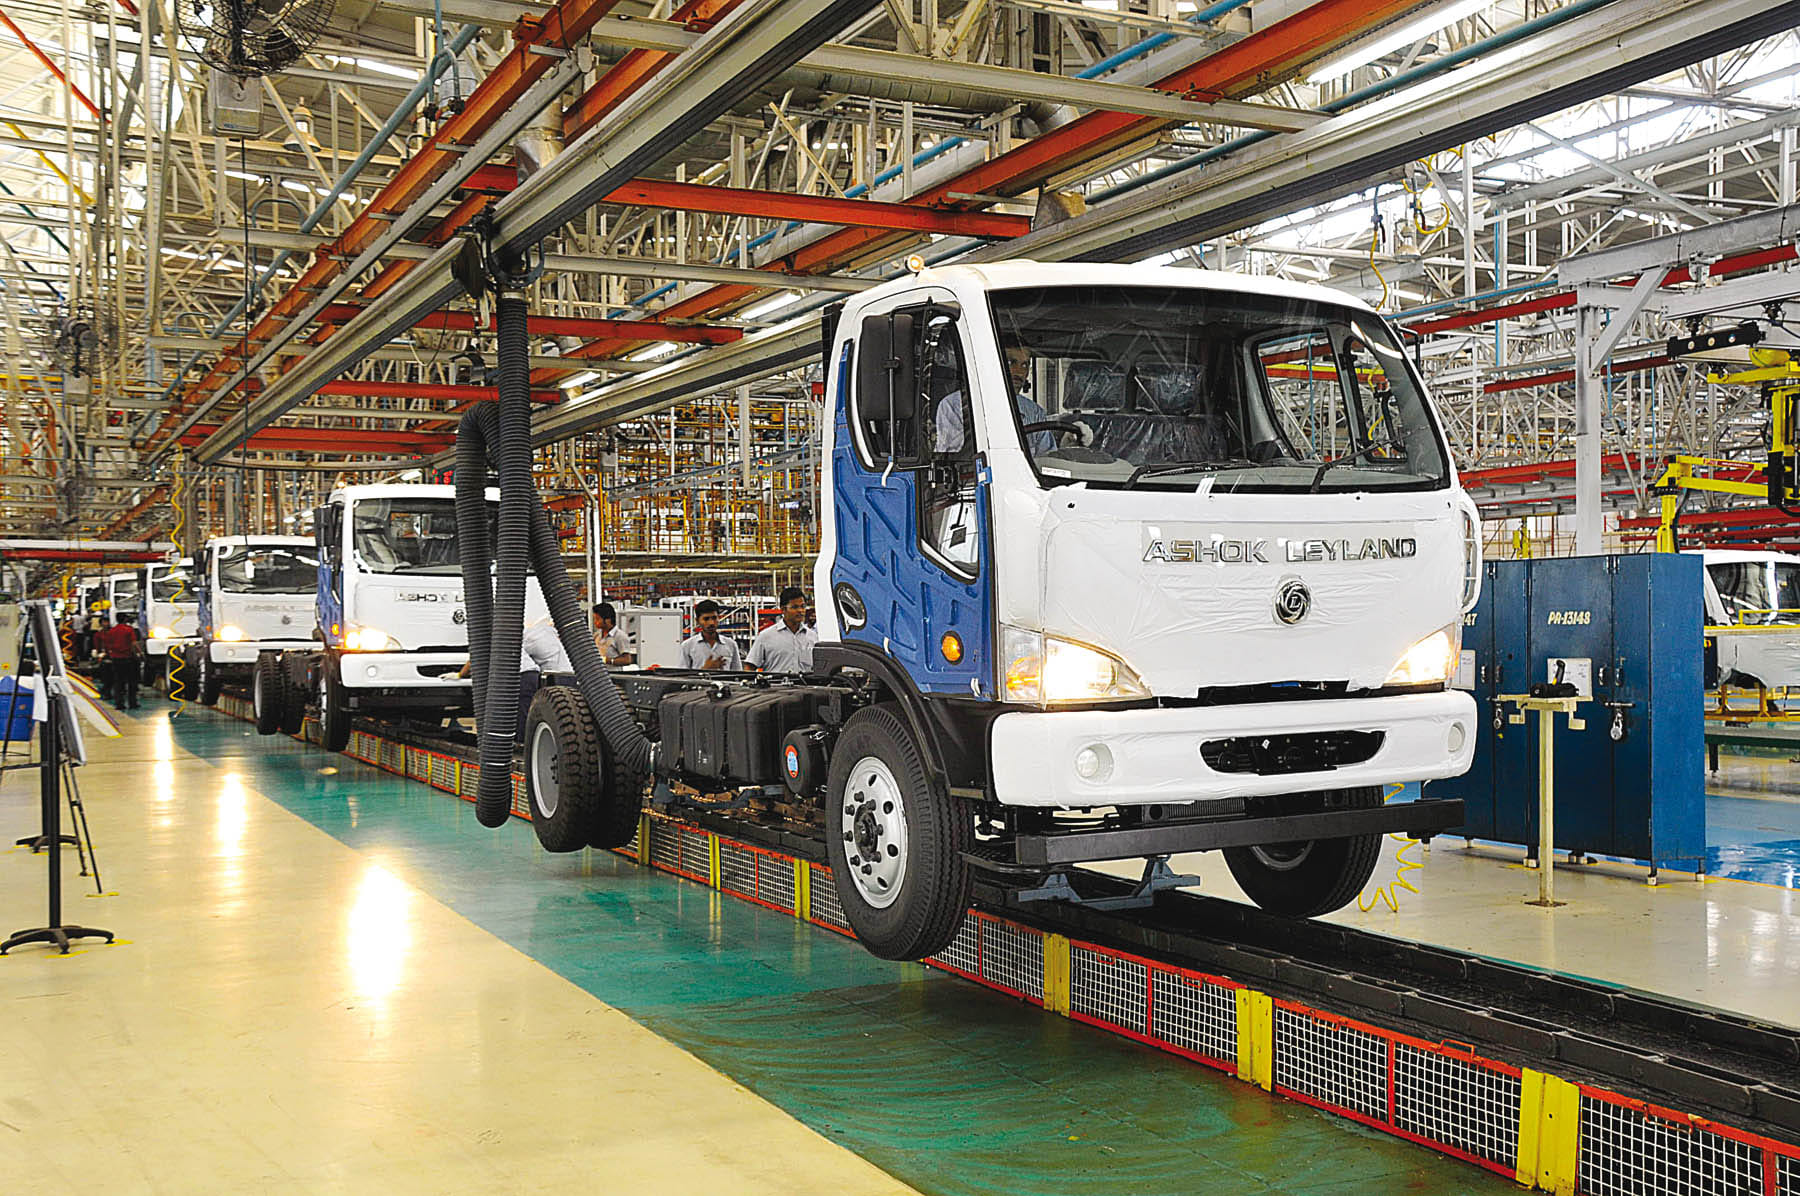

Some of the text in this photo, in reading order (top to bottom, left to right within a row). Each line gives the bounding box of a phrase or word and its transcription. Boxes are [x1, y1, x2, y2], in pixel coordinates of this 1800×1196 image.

[1142, 537, 1417, 563] ASHOK LEYLAND
[1548, 611, 1591, 625] PA-13148
